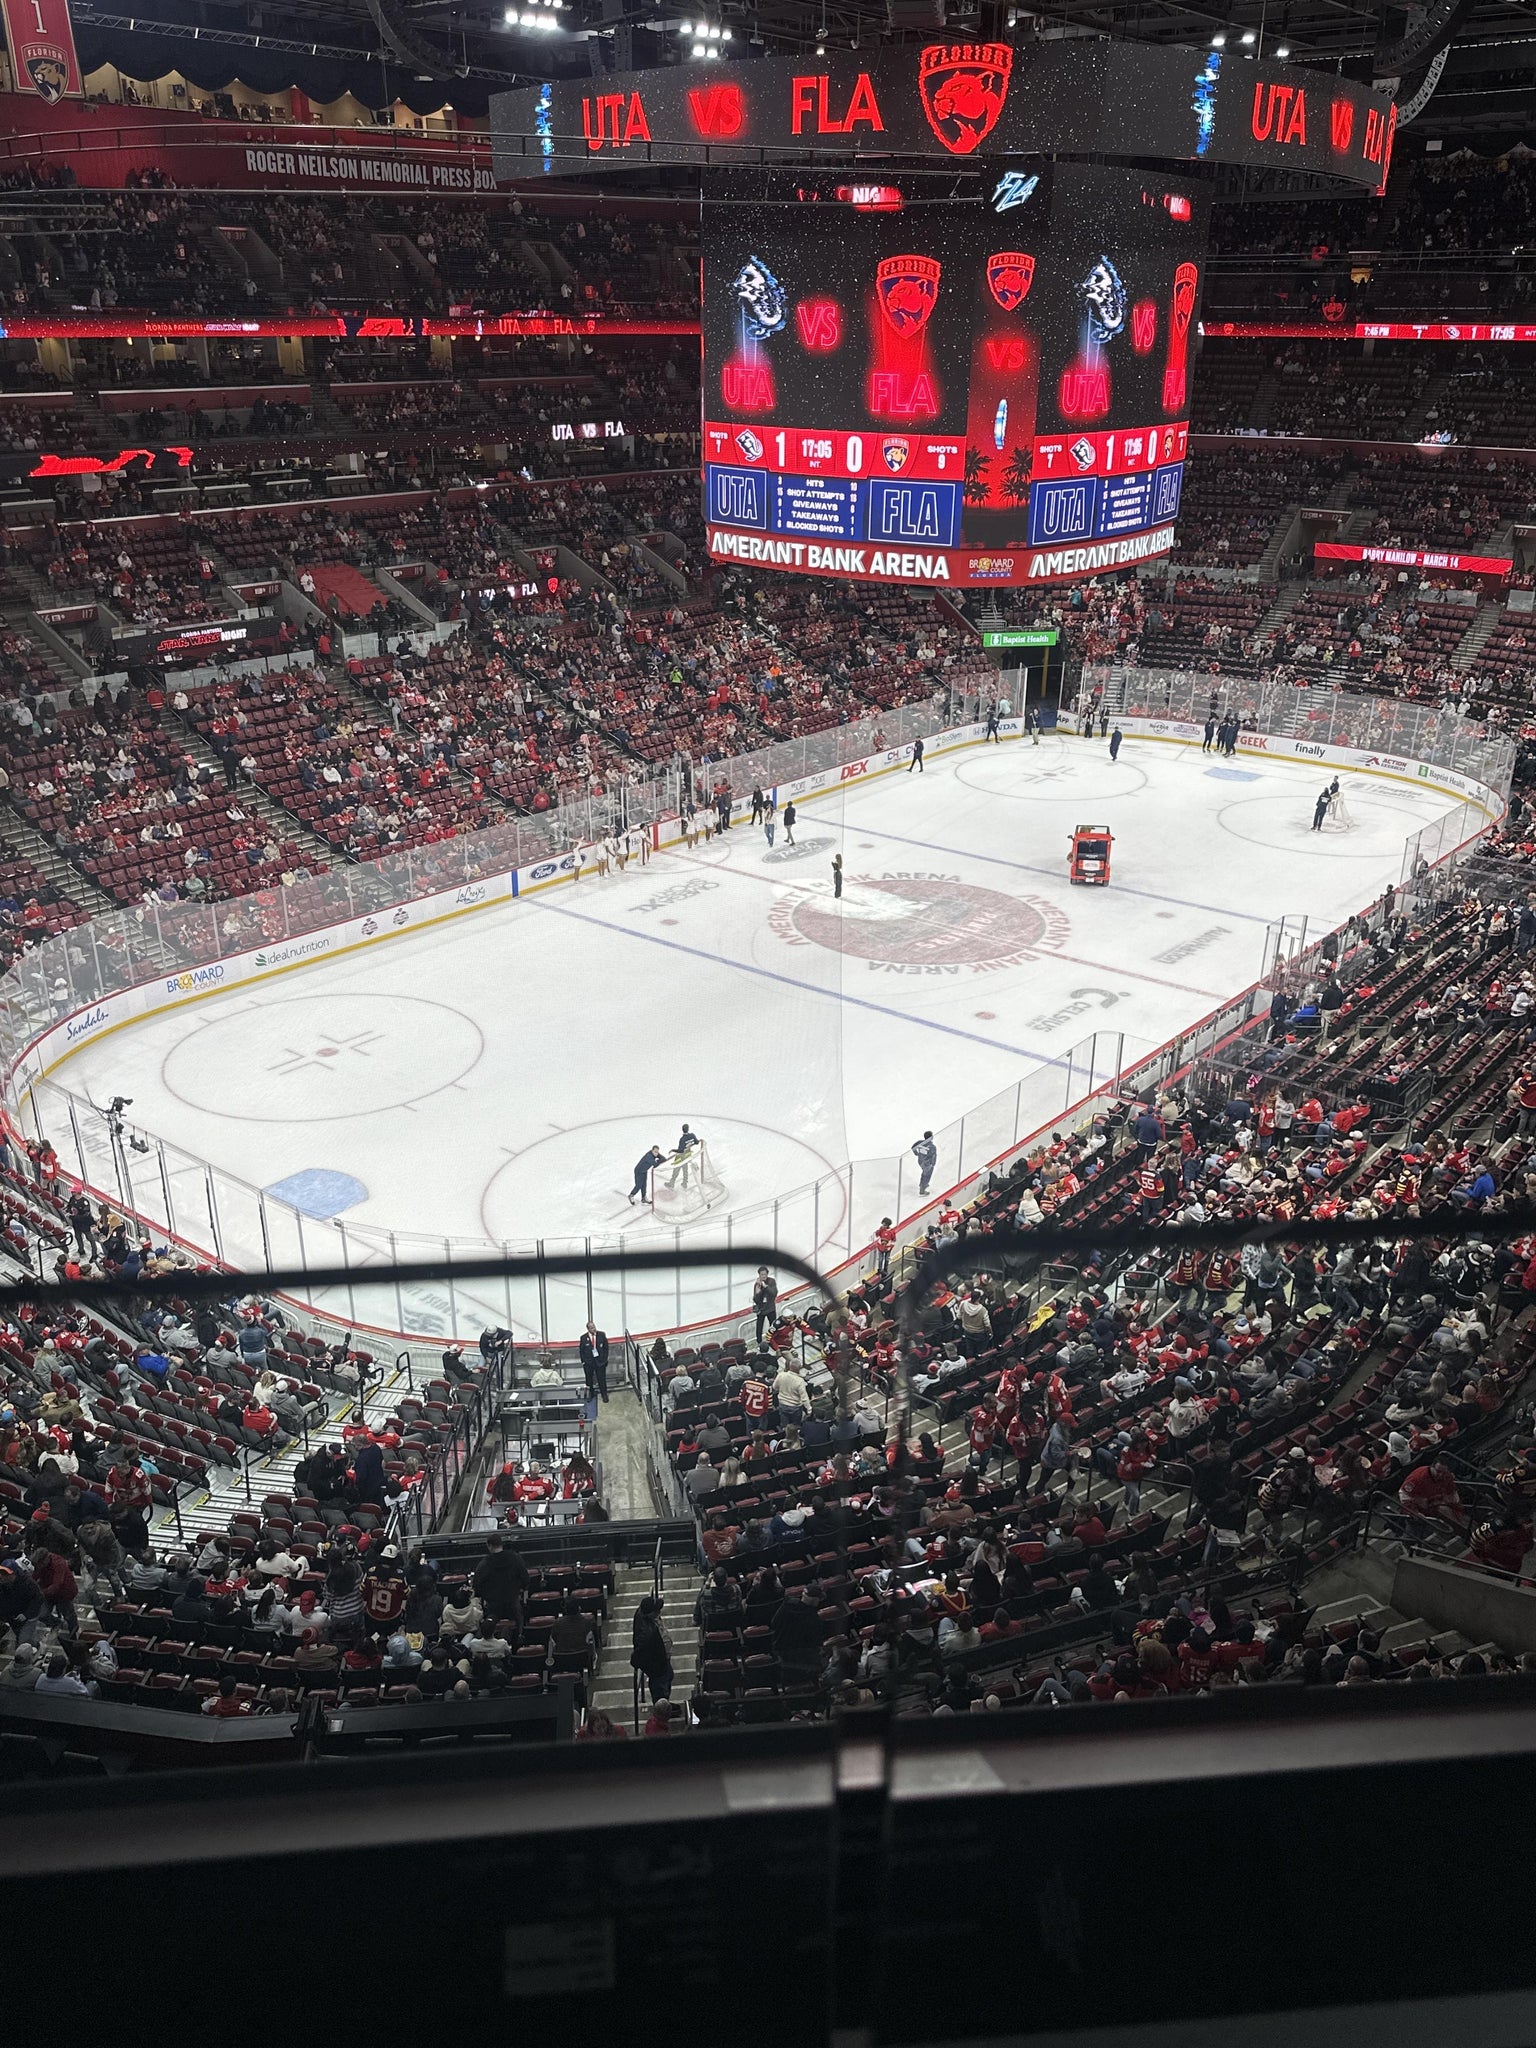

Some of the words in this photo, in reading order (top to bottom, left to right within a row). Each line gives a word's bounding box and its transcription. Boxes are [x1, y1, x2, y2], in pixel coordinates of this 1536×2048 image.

[27, 47, 63, 61] FLORIDA
[929, 45, 1005, 68] FLORIDA
[582, 92, 652, 151] UTA
[689, 88, 742, 135] VS
[792, 74, 885, 135] FLA
[1252, 83, 1307, 146] UTA
[1332, 102, 1354, 149] VS
[1363, 108, 1386, 165] FLA
[245, 150, 297, 175] ROGER
[298, 154, 359, 179] NEILSON
[361, 160, 431, 185] MEMORIAL
[433, 165, 472, 189] PRESS
[473, 169, 498, 191] BOX
[990, 171, 1041, 213] FLA
[884, 261, 935, 277] FLORIDA
[991, 255, 1032, 267] FLORIDA
[145, 324, 172, 332] FLORIDA
[173, 324, 204, 332] PANTHERS
[499, 319, 521, 335] UTA
[553, 319, 574, 335] FLA
[798, 306, 839, 347] VS
[1133, 308, 1156, 348] VS
[1364, 326, 1379, 337] 7:45
[1490, 326, 1516, 340] 17:05
[987, 340, 1025, 369] VS
[722, 367, 775, 407] UTA
[871, 373, 937, 415] FLA
[1062, 374, 1110, 414] UTA
[1163, 368, 1186, 406] FLA
[552, 424, 575, 441] UTA
[582, 423, 597, 438] VS
[604, 421, 625, 437] FLA
[709, 431, 729, 440] SHOTS
[775, 432, 786, 468] 1
[801, 439, 833, 459] 17:05
[846, 436, 863, 473] 0
[926, 445, 959, 455] SHOTS
[1039, 445, 1063, 454] SHOTS
[1106, 434, 1115, 471] 1
[1147, 430, 1158, 465] 0
[806, 478, 825, 488] HITS
[1157, 471, 1179, 516] FLA
[717, 474, 759, 521] UTA
[786, 488, 806, 498] SHOT
[806, 490, 846, 501] ATTEMPTS
[792, 500, 839, 511] GIVEAWAYS
[882, 488, 939, 537] FLA
[1043, 487, 1086, 535] UTA
[791, 510, 840, 523] TAKEAWAYS
[786, 521, 819, 532] BLOCKED
[818, 524, 845, 534] SHOTS
[711, 531, 807, 565] AMERANT
[807, 545, 867, 573] BANK
[869, 554, 951, 580] ARENA
[1028, 542, 1121, 578] AMERANT
[1119, 536, 1152, 563] BANK
[1149, 526, 1175, 555] ARENA
[1385, 550, 1416, 565] MANILOW
[1423, 553, 1448, 567] MARCH
[1449, 556, 1459, 568] 14
[268, 581, 280, 593] 118
[522, 582, 539, 596] FLA
[82, 608, 94, 619] 117
[157, 636, 190, 651] STAR
[189, 631, 222, 648] WARS
[221, 627, 247, 642] NIGHT
[1003, 636, 1026, 645] Baptist
[1027, 634, 1049, 643] Health
[981, 722, 1018, 735] HNDA
[887, 751, 899, 761] CH
[1294, 743, 1326, 759] finally
[840, 759, 869, 781] DEX
[1382, 758, 1408, 768] ACTION
[1428, 769, 1449, 784] Baptist
[1448, 775, 1466, 790] Health
[534, 864, 556, 878] Ford
[881, 871, 961, 882] ARENA
[767, 891, 813, 946] AMERANT
[1018, 893, 1072, 950] AMERANT
[267, 938, 330, 966] idealnutrition
[969, 950, 1041, 974] BANK
[868, 959, 961, 976] ARENA
[166, 964, 225, 993] BROWARD
[194, 977, 226, 991] COUNTY
[67, 1007, 109, 1041] Sandals
[1031, 1001, 1092, 1032] CELSIUS
[1141, 1177, 1155, 1190] 55
[746, 1389, 764, 1409] 72
[371, 1589, 392, 1613] 19
